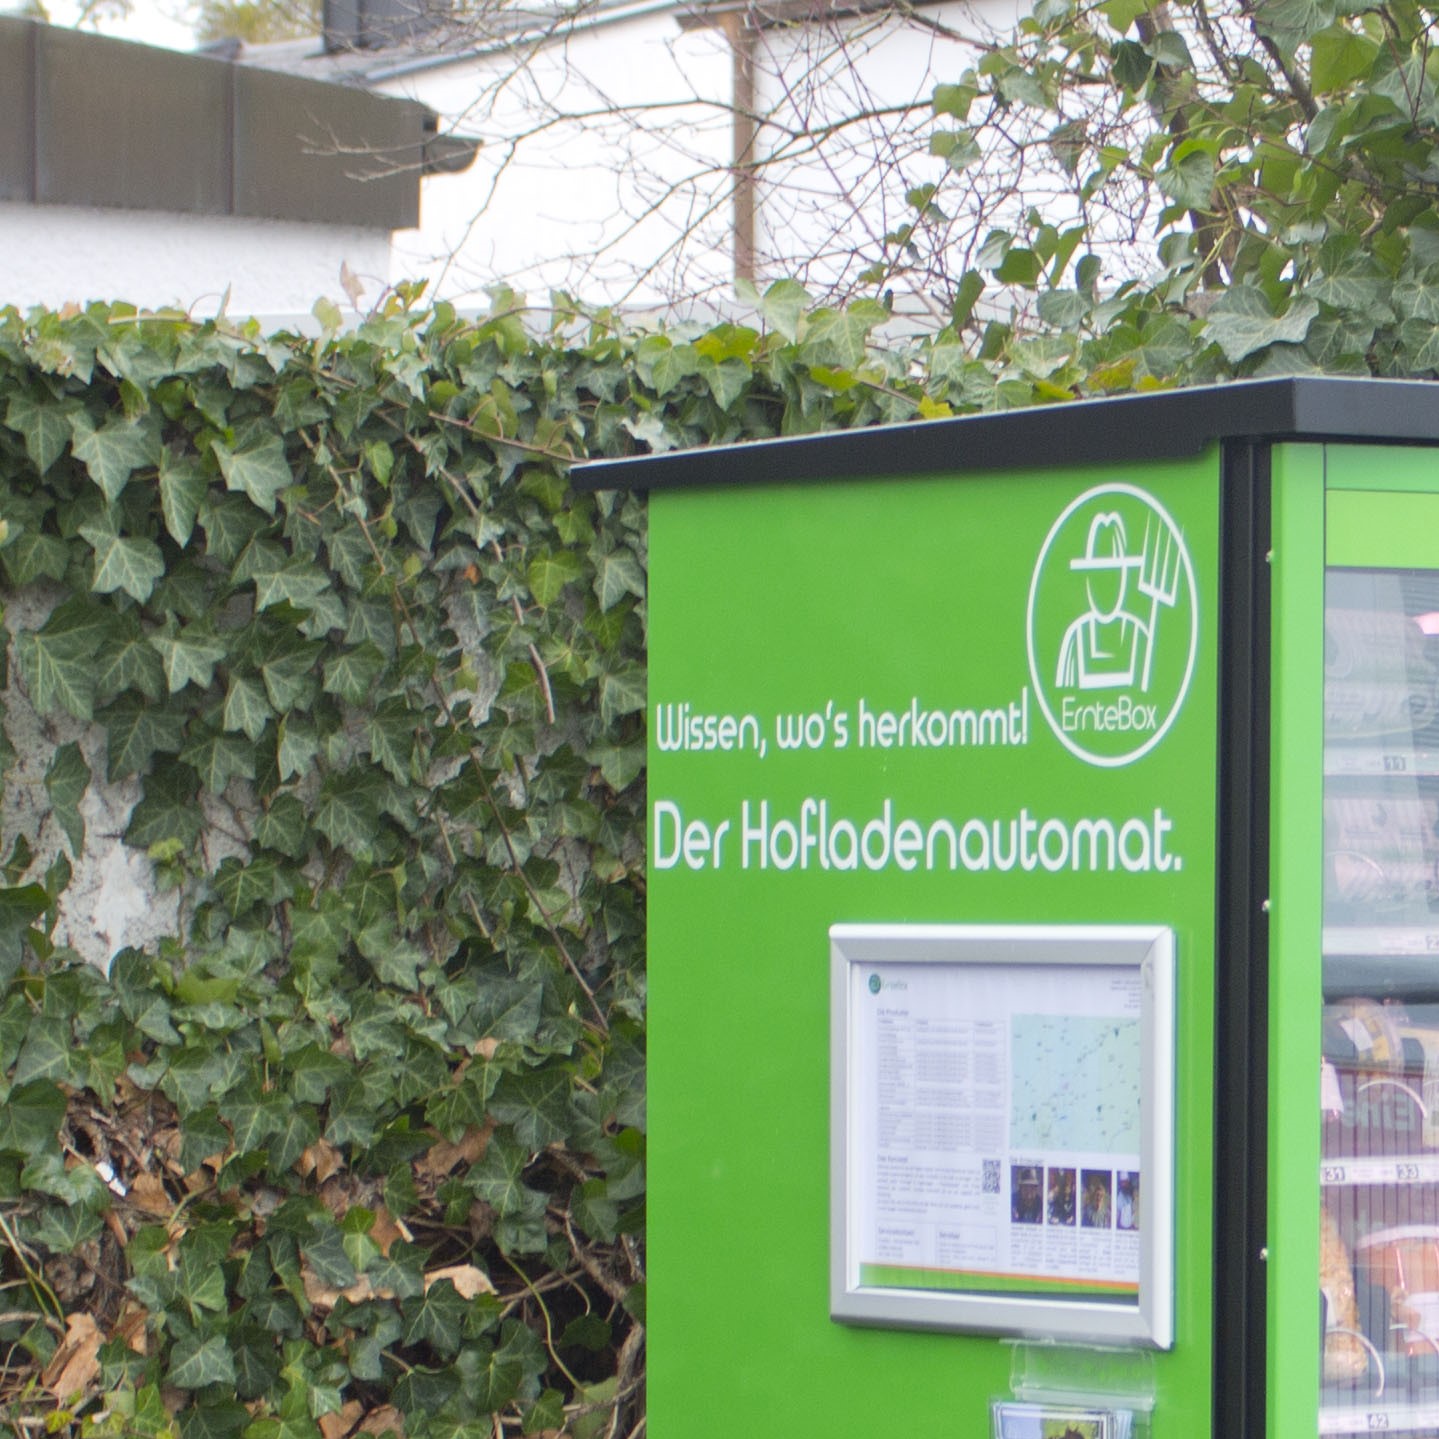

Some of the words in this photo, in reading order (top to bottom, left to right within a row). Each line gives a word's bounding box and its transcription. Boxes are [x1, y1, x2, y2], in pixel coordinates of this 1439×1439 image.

[656, 703, 767, 759] Wissen,
[776, 700, 848, 750] wo's
[858, 686, 1028, 748] herkommt!
[1062, 697, 1157, 731] ErnteBox
[652, 799, 729, 870] Der
[741, 798, 1182, 873] Hofladenautomat.
[1399, 1164, 1417, 1179] 33
[1370, 1413, 1388, 1429] 42
